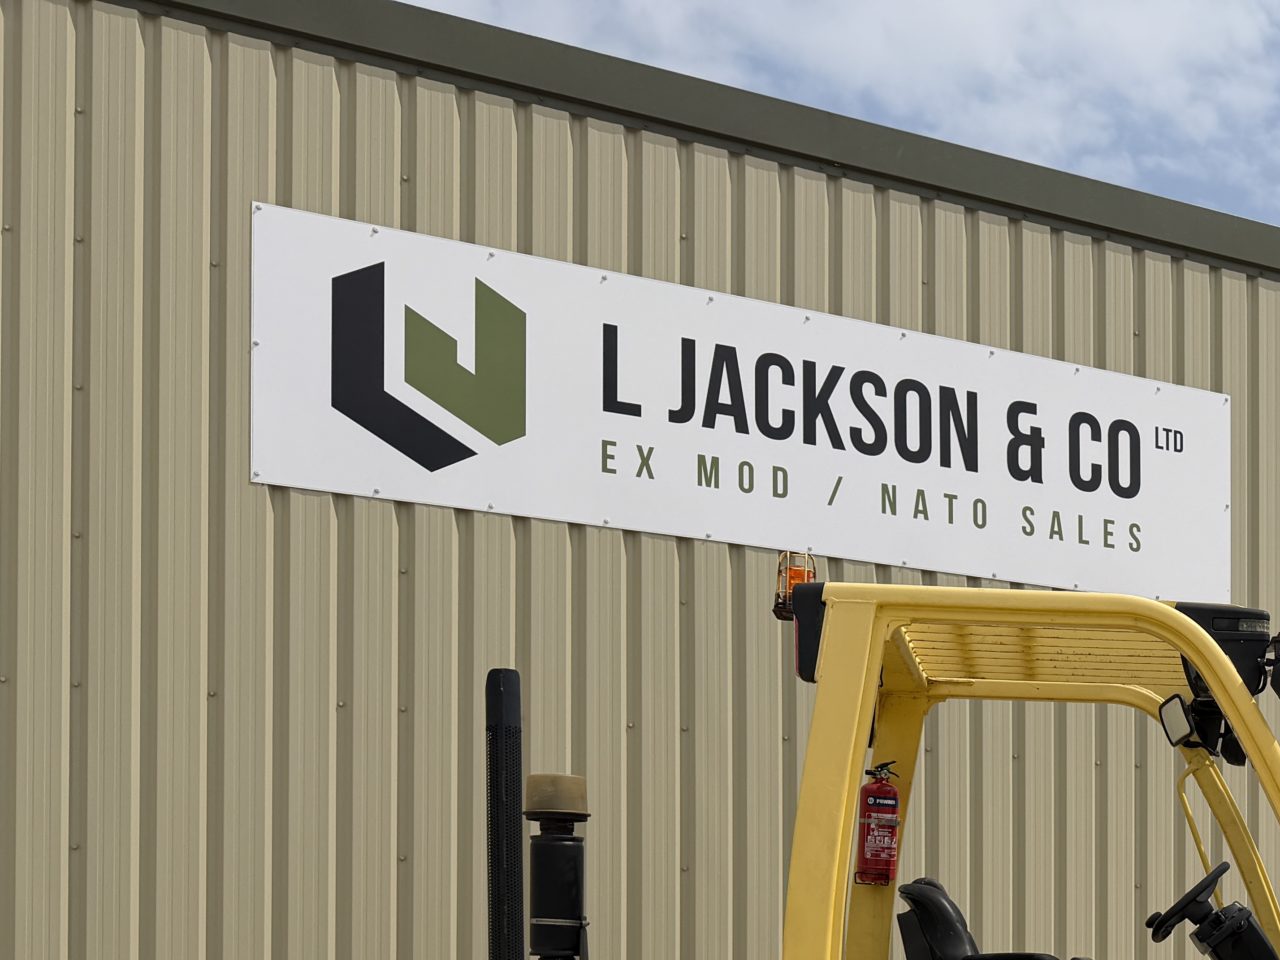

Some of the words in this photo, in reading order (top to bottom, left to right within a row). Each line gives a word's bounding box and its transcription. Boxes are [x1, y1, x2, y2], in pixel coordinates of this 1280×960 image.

[602, 322, 642, 418] L
[667, 337, 979, 474] JACKSON
[1006, 400, 1046, 485] &
[1068, 411, 1142, 500] CO
[1154, 425, 1184, 454] LTD
[601, 439, 655, 480] EX
[697, 453, 789, 499] MOD
[827, 475, 844, 506] /
[881, 482, 987, 530] NATO
[1021, 505, 1141, 553] SALES
